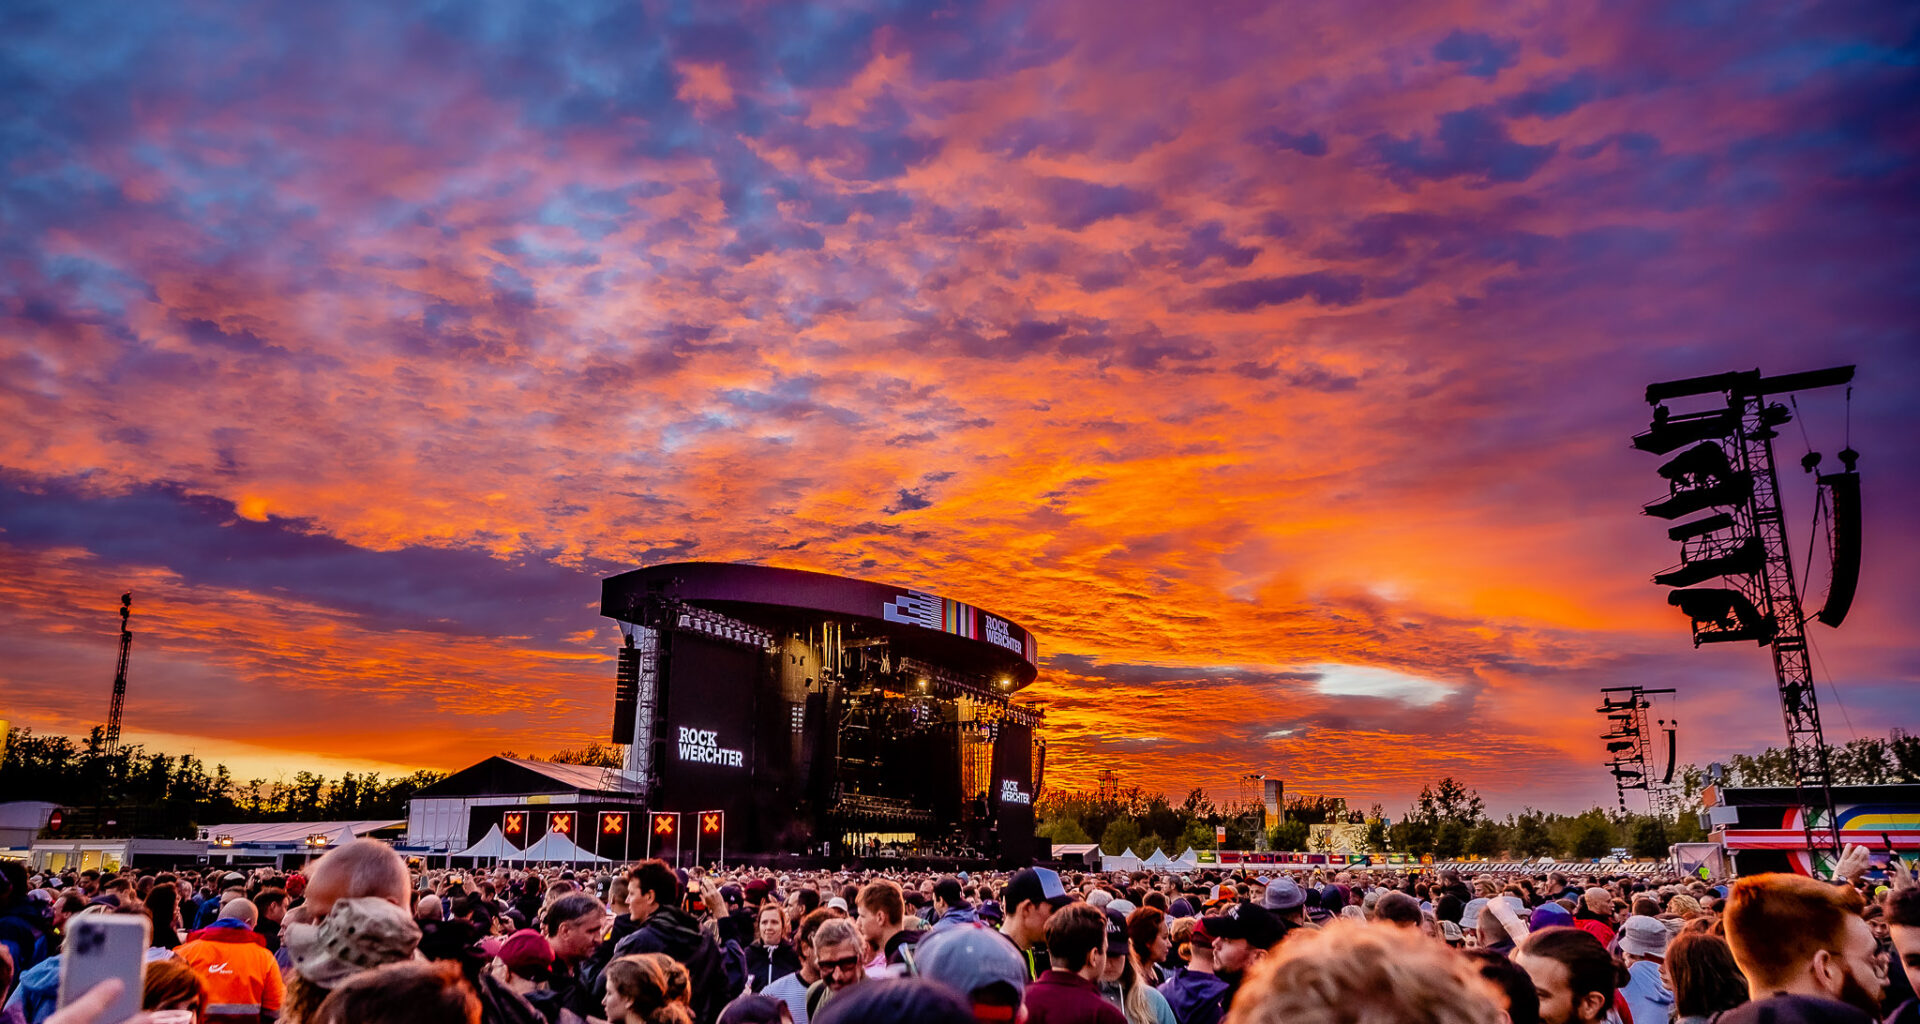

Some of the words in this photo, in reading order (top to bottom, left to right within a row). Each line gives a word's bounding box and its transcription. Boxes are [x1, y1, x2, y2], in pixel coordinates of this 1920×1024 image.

[985, 615, 1009, 636] ROCK
[985, 627, 1022, 655] WERCHTER
[678, 726, 718, 747] ROCK
[678, 742, 743, 767] WERCHTER
